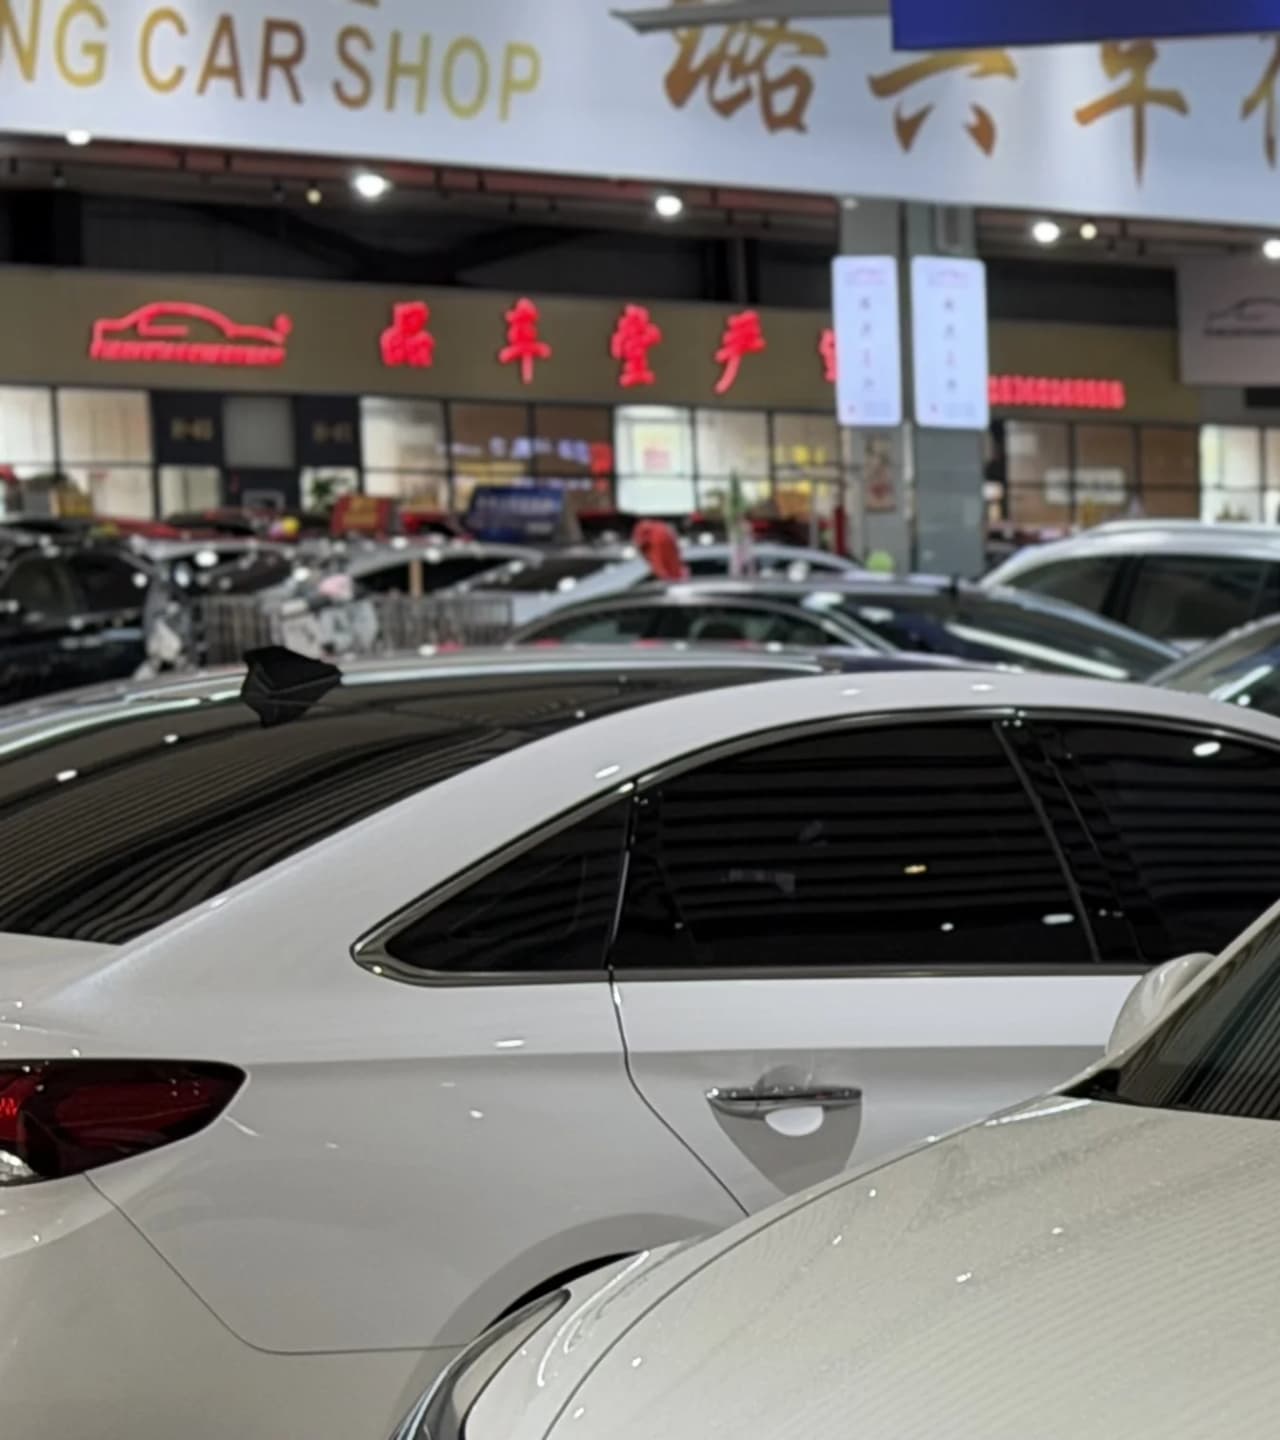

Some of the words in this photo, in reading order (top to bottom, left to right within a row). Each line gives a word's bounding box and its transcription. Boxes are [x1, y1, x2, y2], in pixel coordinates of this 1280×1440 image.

[139, 6, 307, 105] CAR
[332, 23, 542, 123] SHOP
[380, 297, 838, 395] 品车堂严
